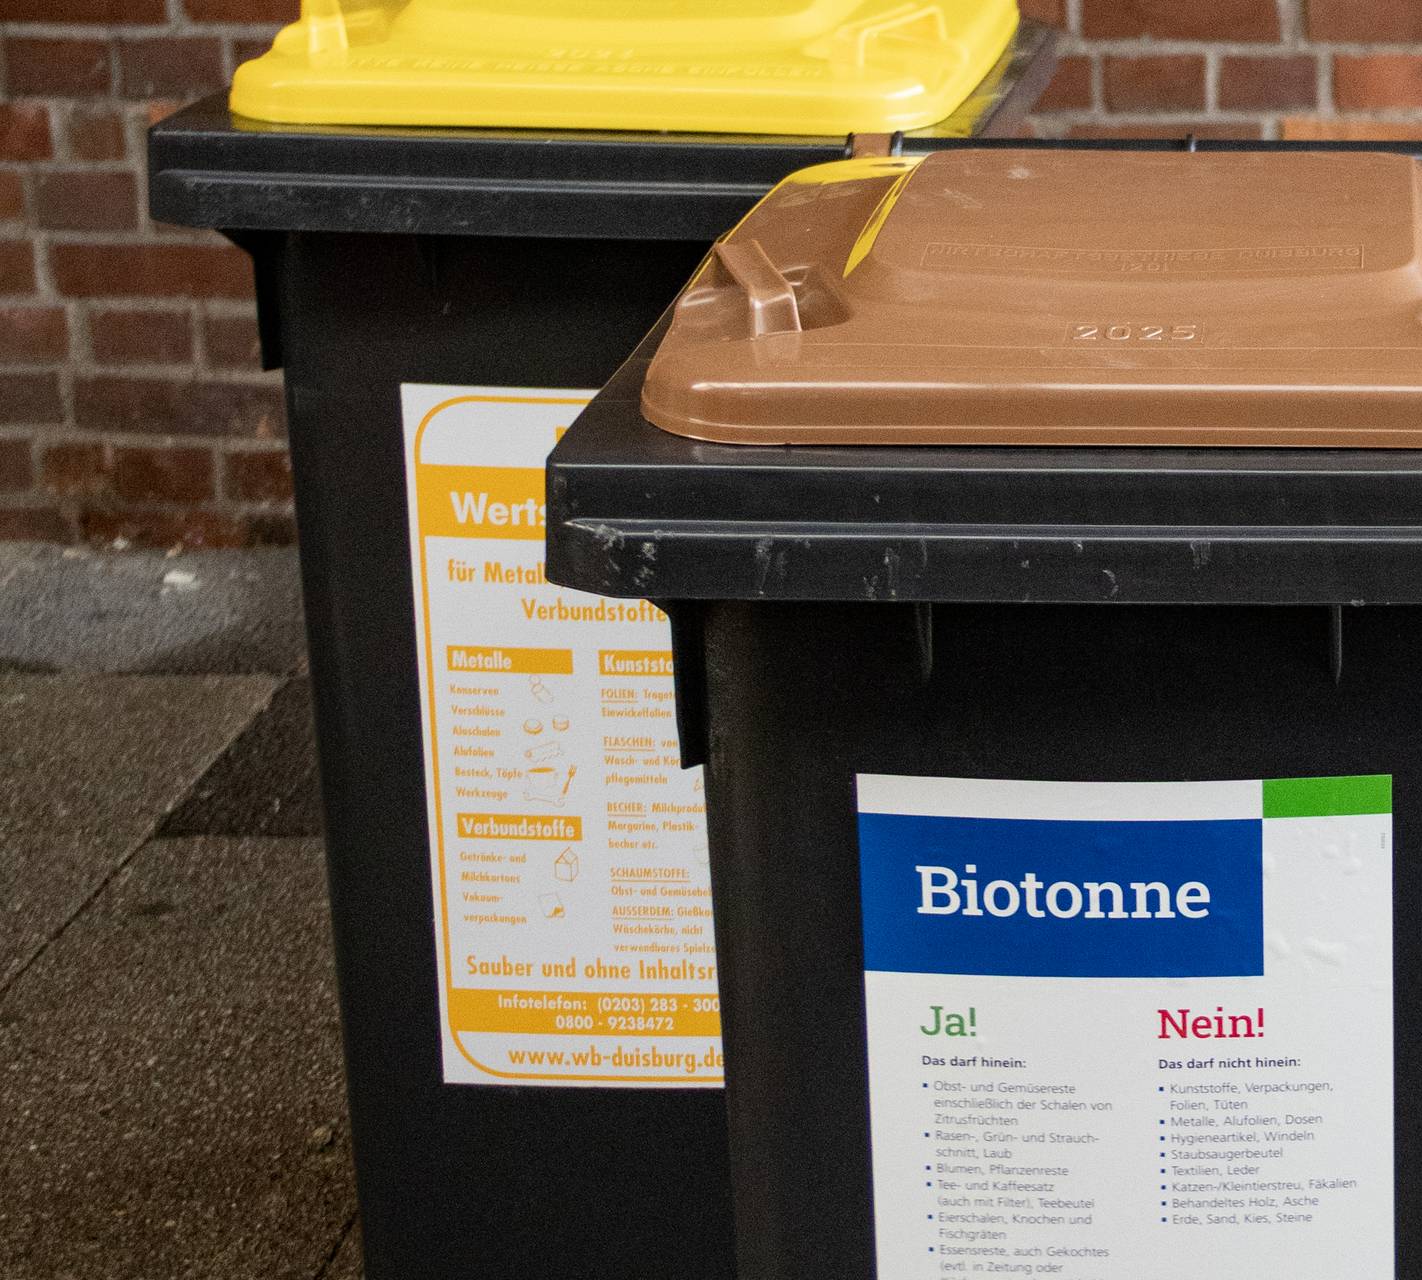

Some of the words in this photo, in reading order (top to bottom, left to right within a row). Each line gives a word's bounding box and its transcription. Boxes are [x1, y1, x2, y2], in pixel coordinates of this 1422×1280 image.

[1072, 323, 1198, 341] 2025
[448, 559, 475, 583] für
[484, 561, 549, 585] Metal
[521, 598, 668, 623] Verbundstoffe
[452, 650, 512, 670] Metalle
[450, 684, 499, 696] Konserven
[642, 756, 660, 766] und
[461, 816, 576, 837] Verbundstoffe
[509, 853, 527, 864] und
[640, 886, 657, 897] und
[915, 863, 1211, 919] Biotonne
[467, 955, 533, 977] Sauber
[542, 957, 576, 978] und
[584, 957, 631, 979] ohne
[498, 993, 587, 1011] Infotelefon:
[598, 996, 645, 1014] (0203)
[651, 997, 678, 1012] 283
[555, 1014, 594, 1030] 0800
[608, 1016, 674, 1031] 9238472
[920, 1005, 977, 1037] Ja!
[1157, 1007, 1265, 1039] Nein!
[508, 1044, 724, 1074] www.wb-duisburg.de
[922, 1056, 945, 1066] Das
[950, 1056, 976, 1067] darf
[981, 1057, 1026, 1068] hinein:
[1159, 1060, 1182, 1069] Das
[1187, 1059, 1214, 1069] darf
[1219, 1058, 1251, 1068] nicht
[1256, 1057, 1300, 1068] hinein:
[934, 1081, 966, 1091] Obst-
[970, 1082, 994, 1092] und
[998, 1082, 1076, 1094] Gemüsereste
[1170, 1083, 1241, 1094] Kunststoffe,
[1245, 1081, 1334, 1093] Verpackungen,
[934, 1098, 1013, 1109] einschließlich
[1017, 1099, 1036, 1110] der
[1040, 1100, 1086, 1111] Schalen
[1091, 1103, 1112, 1111] von
[1170, 1100, 1208, 1111] Folien,
[1214, 1100, 1248, 1110] Tüten
[935, 1114, 1018, 1126] Zitrusfrüchten
[1170, 1117, 1219, 1127] Metalle,
[1223, 1115, 1280, 1126] Alufolien,
[1285, 1115, 1323, 1124] Dosen
[984, 1132, 1018, 1142] Grün-
[1022, 1132, 1045, 1143] und
[1049, 1132, 1100, 1143] Strauch-
[1171, 1132, 1260, 1145] Hygieneartikel,
[1264, 1131, 1314, 1141] Windeln
[984, 1149, 1012, 1159] Laub
[1171, 1148, 1283, 1161] Staubsaugerbeutel
[937, 1163, 984, 1175] Blumen,
[990, 1164, 1069, 1176] Pflanzenreste
[1172, 1166, 1223, 1176] Textilien,
[1227, 1165, 1260, 1175] Leder
[938, 1180, 960, 1190] Tee-
[965, 1181, 988, 1191] und
[993, 1181, 1055, 1192] Kaffeesatz
[1308, 1178, 1357, 1189] Fäkalien
[938, 1196, 970, 1208] (auch
[974, 1197, 994, 1207] mit
[1039, 1198, 1095, 1208] Teebeutel
[1172, 1198, 1245, 1208] Behandeltes
[1249, 1198, 1278, 1208] Holz,
[1282, 1196, 1319, 1206] Asche
[939, 1213, 1008, 1224] Eierschalen,
[1013, 1213, 1065, 1224] Knochen
[1069, 1214, 1092, 1224] und
[1173, 1215, 1203, 1225] Erde,
[1206, 1214, 1240, 1225] Sand,
[1244, 1214, 1271, 1224] Kies,
[1276, 1212, 1312, 1223] Steine
[939, 1229, 1006, 1241] Fischgräten
[940, 1245, 1009, 1257] Essensreste,
[1014, 1246, 1042, 1256] auch
[1047, 1247, 1110, 1257] Gekochtes
[973, 1263, 984, 1272] in
[988, 1262, 1032, 1274] Zeitung
[1036, 1263, 1063, 1273] oder
